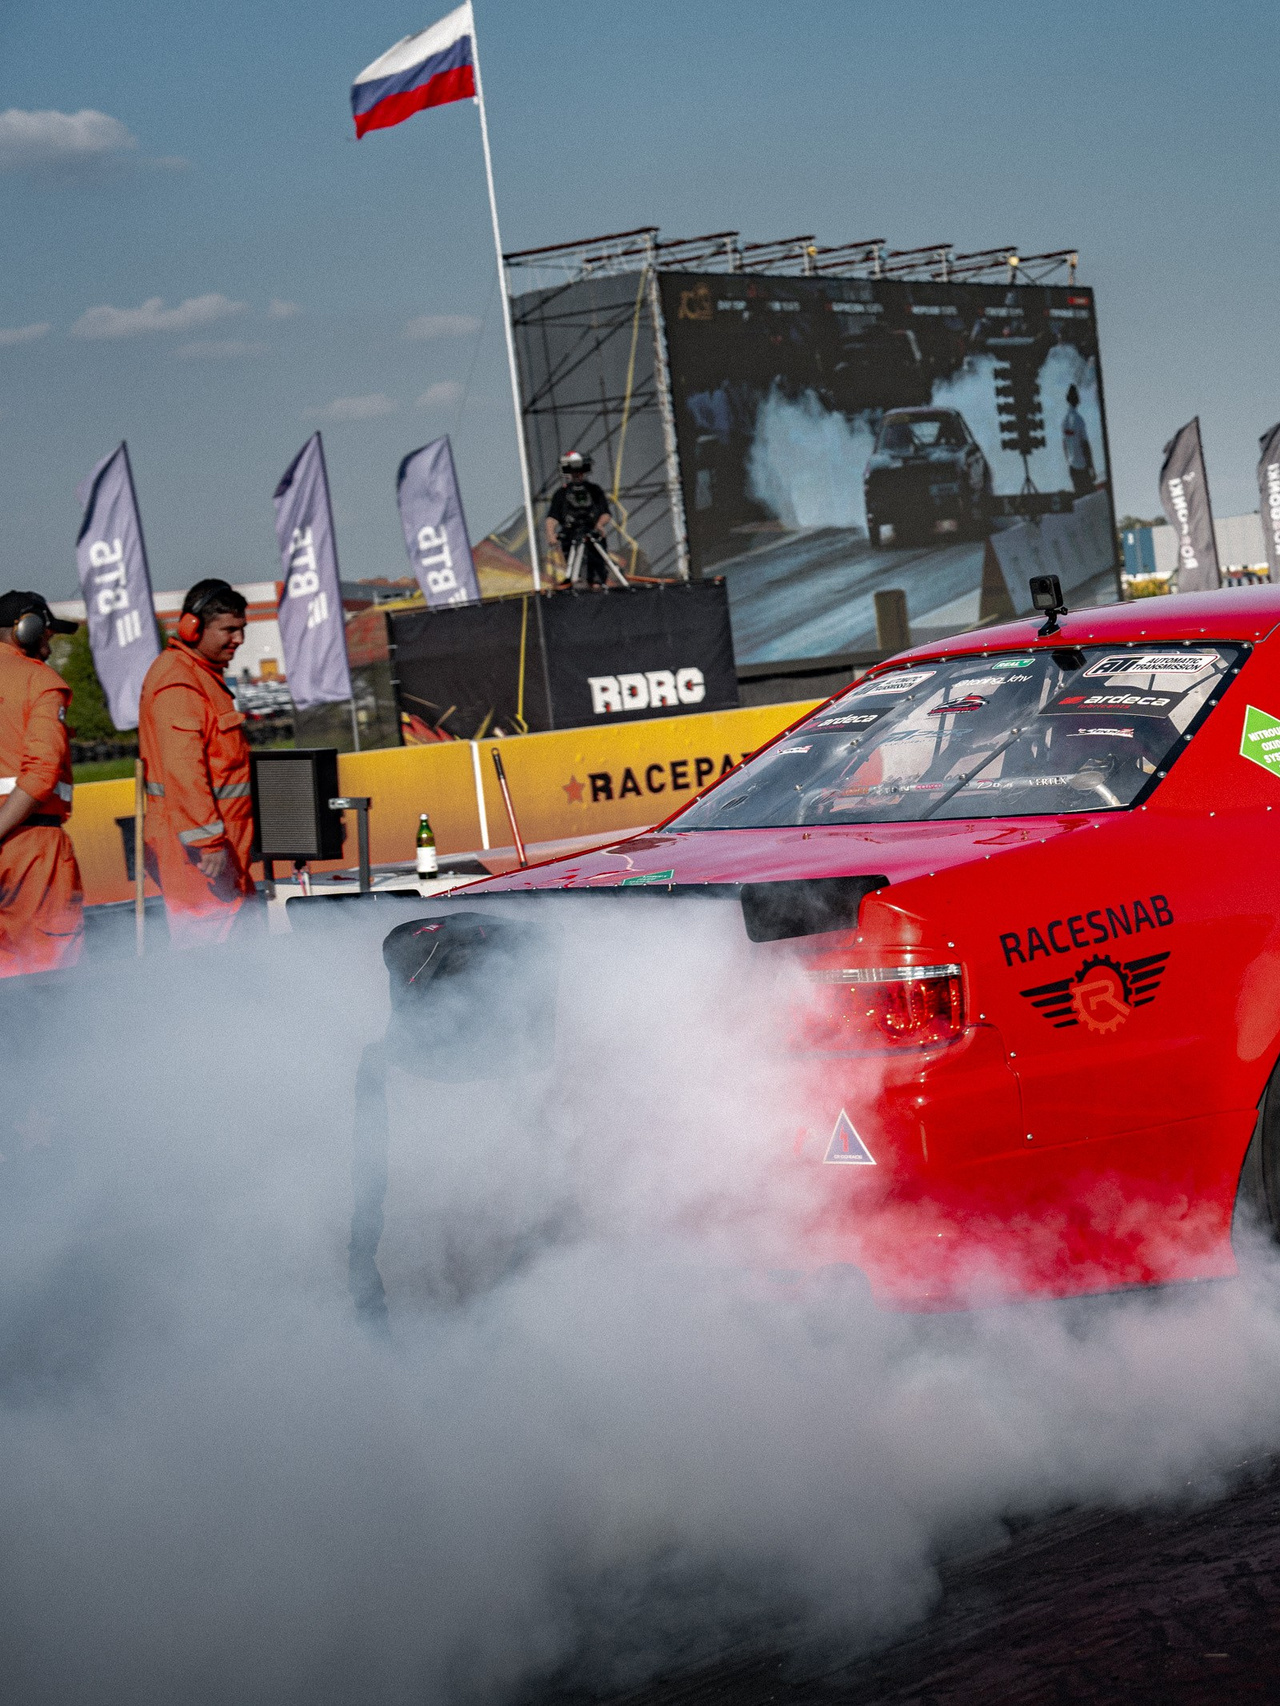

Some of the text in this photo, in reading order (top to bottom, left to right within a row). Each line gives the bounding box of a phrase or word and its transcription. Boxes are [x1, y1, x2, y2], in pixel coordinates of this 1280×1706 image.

[1131, 663, 1202, 671] TRANSMISSION
[587, 666, 707, 715] RDRC
[1083, 693, 1171, 706] ardeca
[817, 713, 879, 727] ardeca
[588, 751, 755, 803] RACEPA
[999, 894, 1175, 967] RACESNAB
